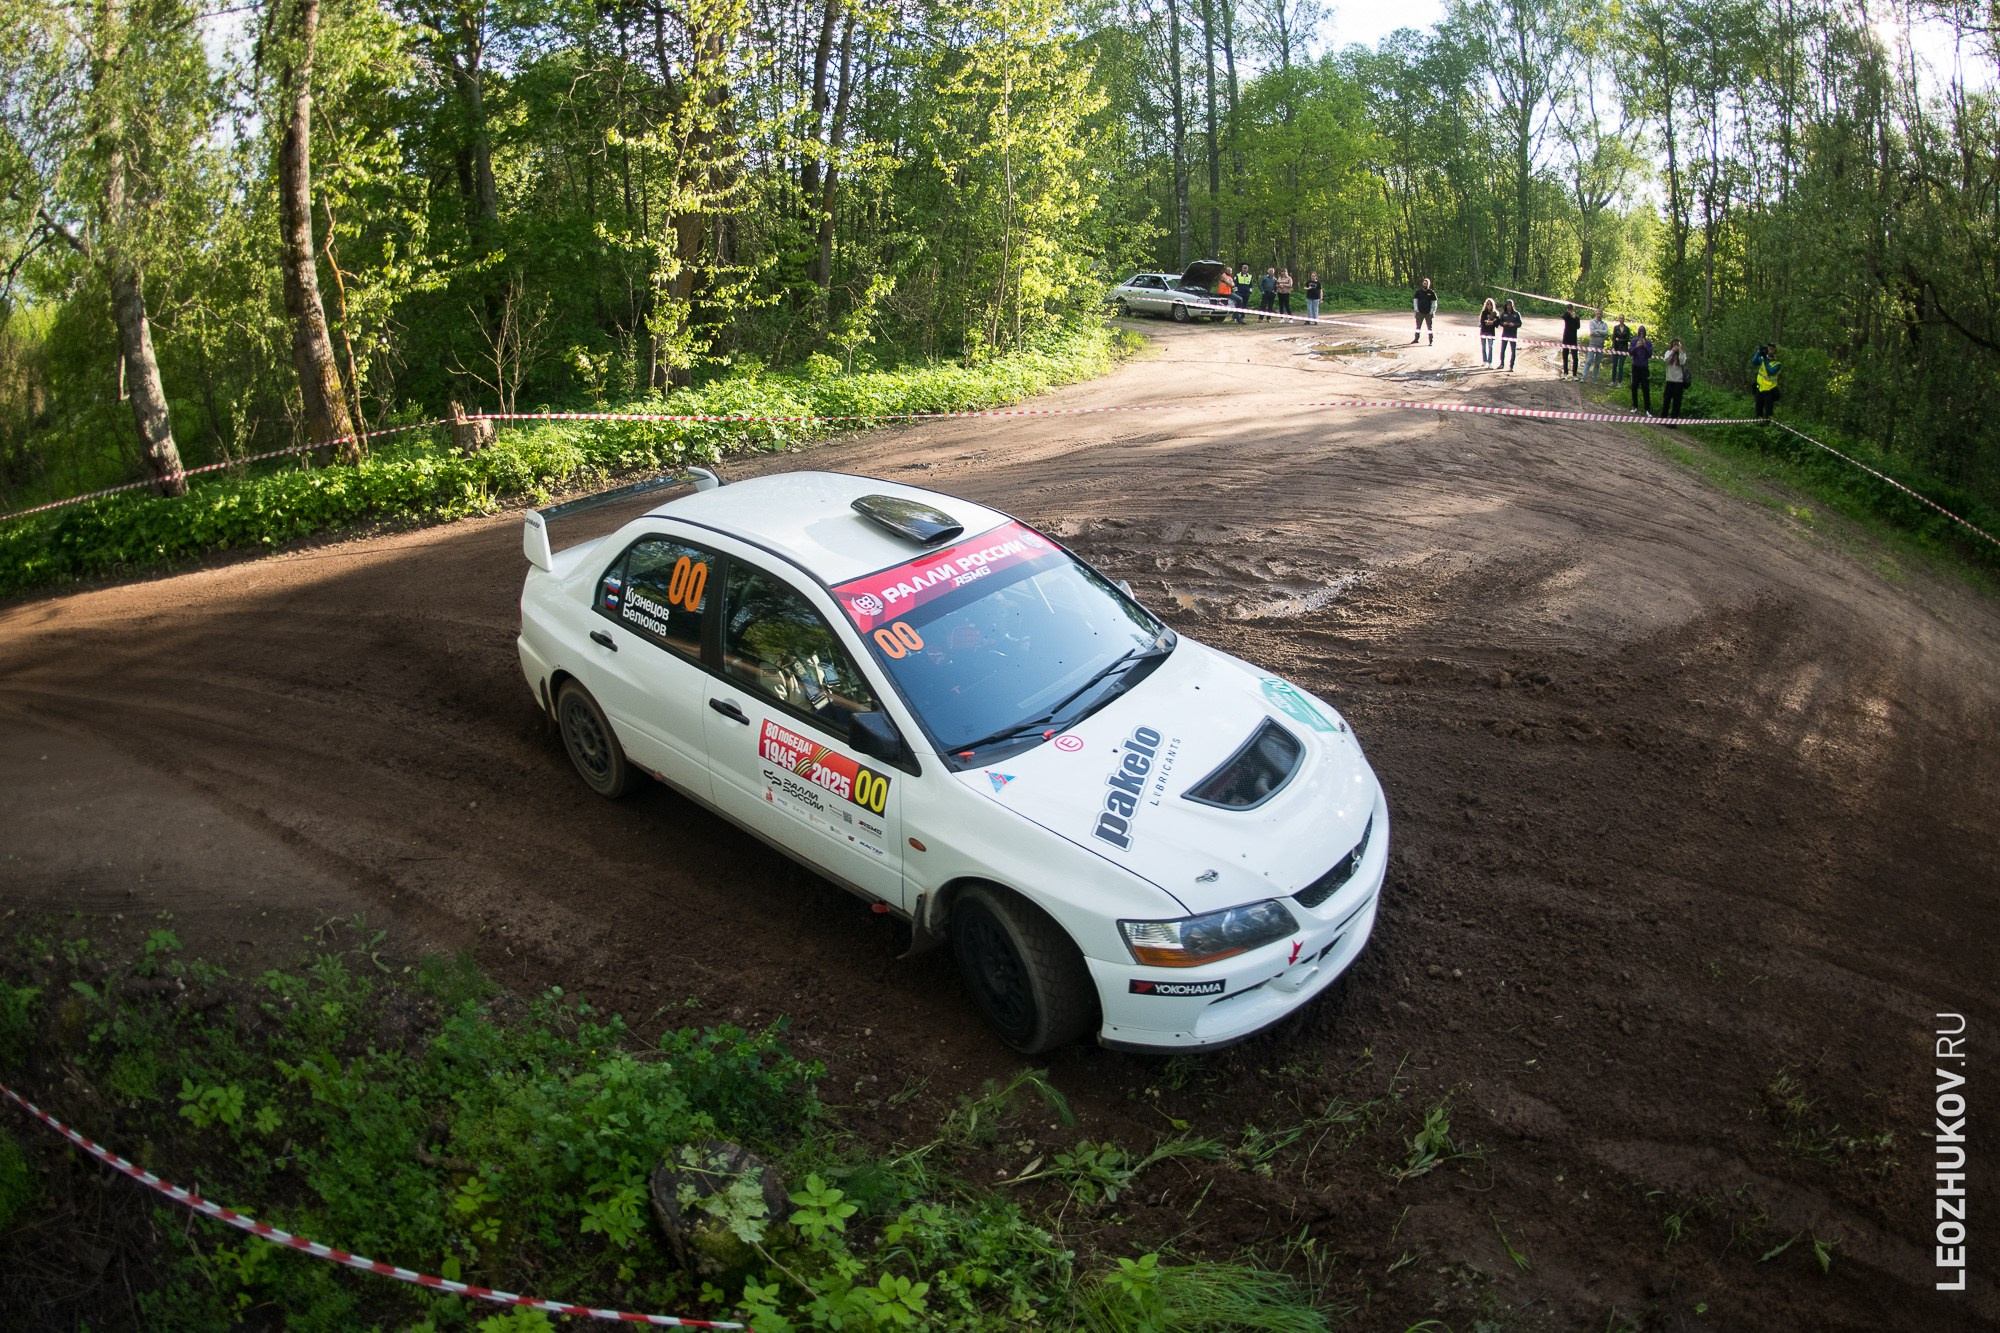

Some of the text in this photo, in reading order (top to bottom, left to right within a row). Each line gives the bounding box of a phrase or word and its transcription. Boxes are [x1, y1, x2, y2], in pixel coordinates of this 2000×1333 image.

[669, 556, 707, 612] 00
[881, 540, 1027, 604] РАЛЛИ РОССИИ
[622, 605, 667, 636] Белюков
[625, 586, 670, 621] Кузнецов
[873, 622, 924, 659] 00
[765, 722, 813, 755] 80 ПОБЕДА!
[764, 739, 851, 800] 1945 2025
[1095, 726, 1162, 849] pakelo
[1150, 738, 1181, 806] LUBRICANTS
[782, 785, 824, 812] РОССИИ
[854, 770, 888, 812] 00
[1154, 983, 1222, 994] YOKOHAMA
